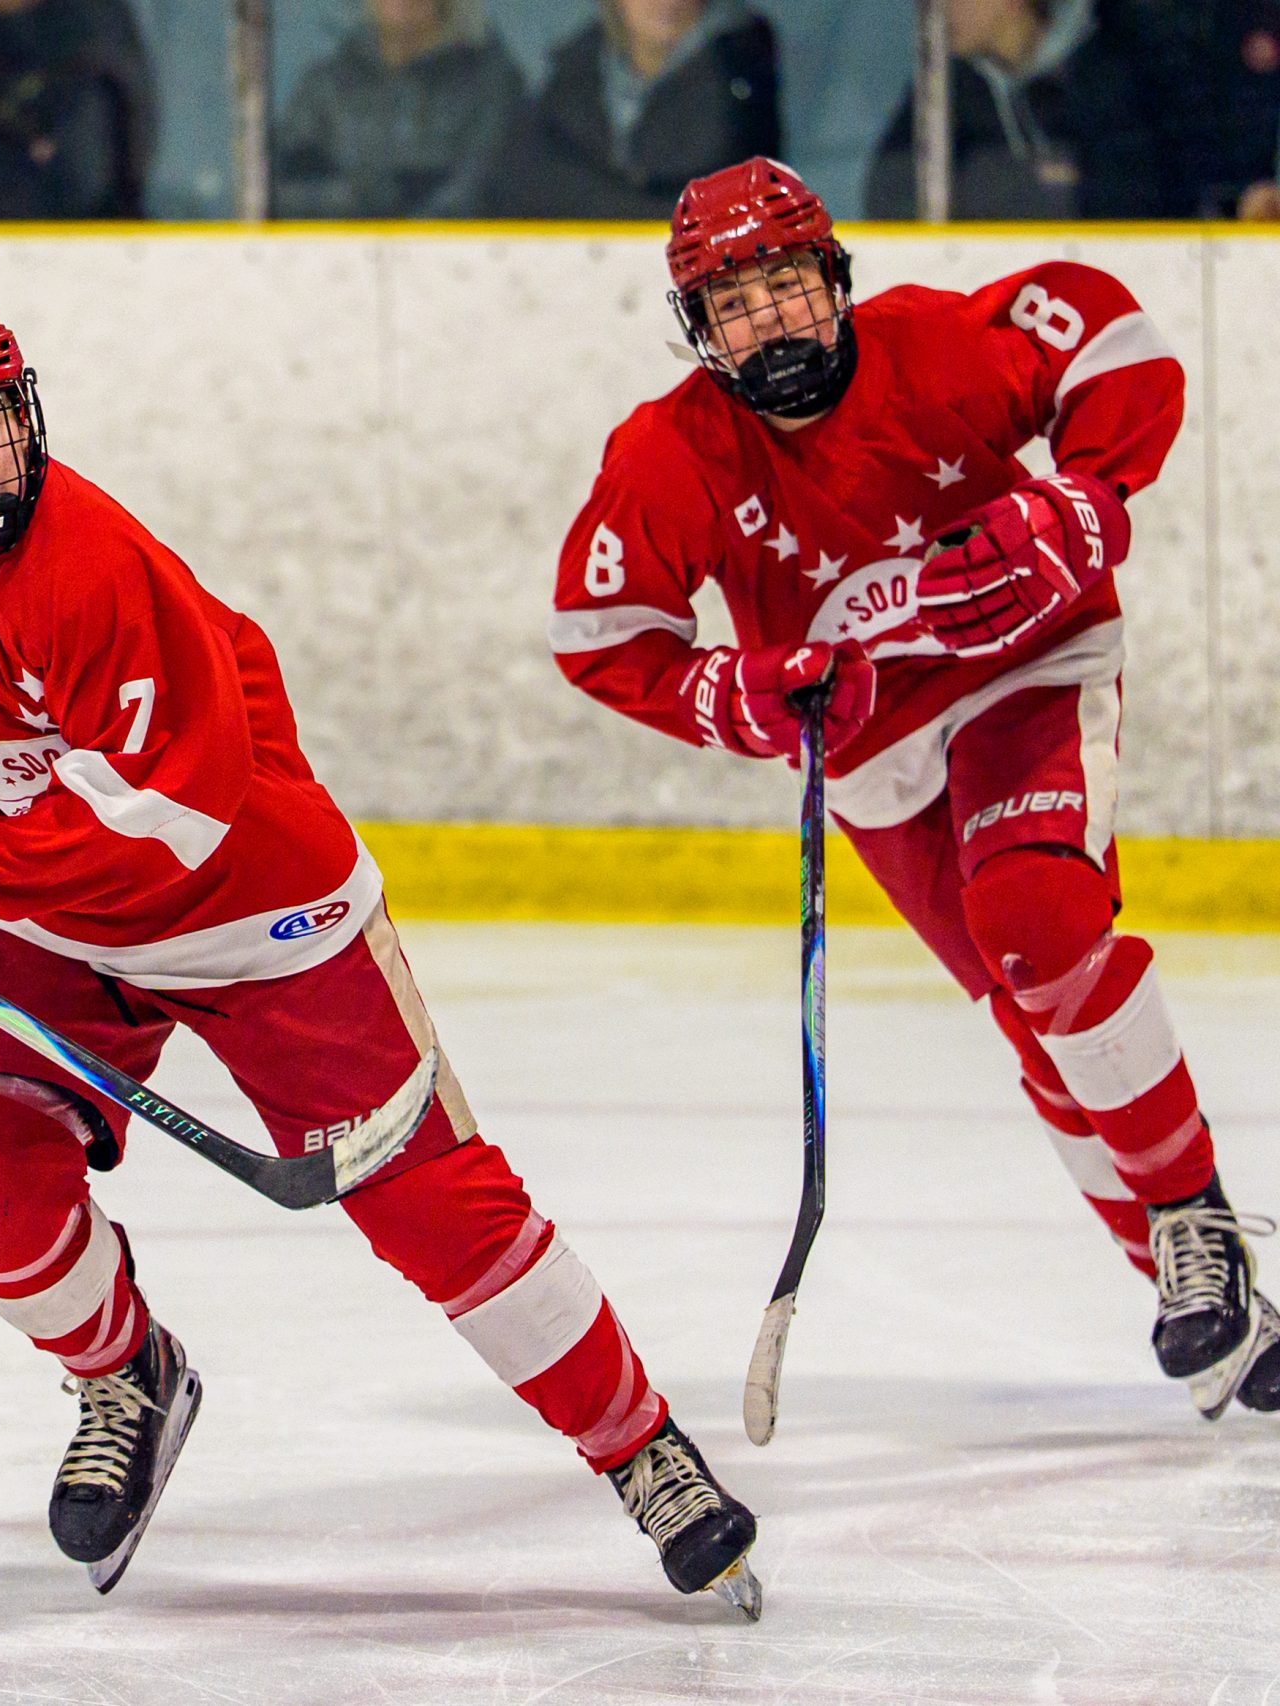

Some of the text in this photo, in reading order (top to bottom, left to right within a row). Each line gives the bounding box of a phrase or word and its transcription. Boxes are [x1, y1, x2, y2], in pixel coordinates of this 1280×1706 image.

[1010, 283, 1085, 351] 8
[585, 523, 625, 597] 8
[845, 574, 907, 622] SOO
[120, 678, 155, 754] 7
[963, 790, 1084, 843] BAUER
[128, 1091, 209, 1144] FLYLITE
